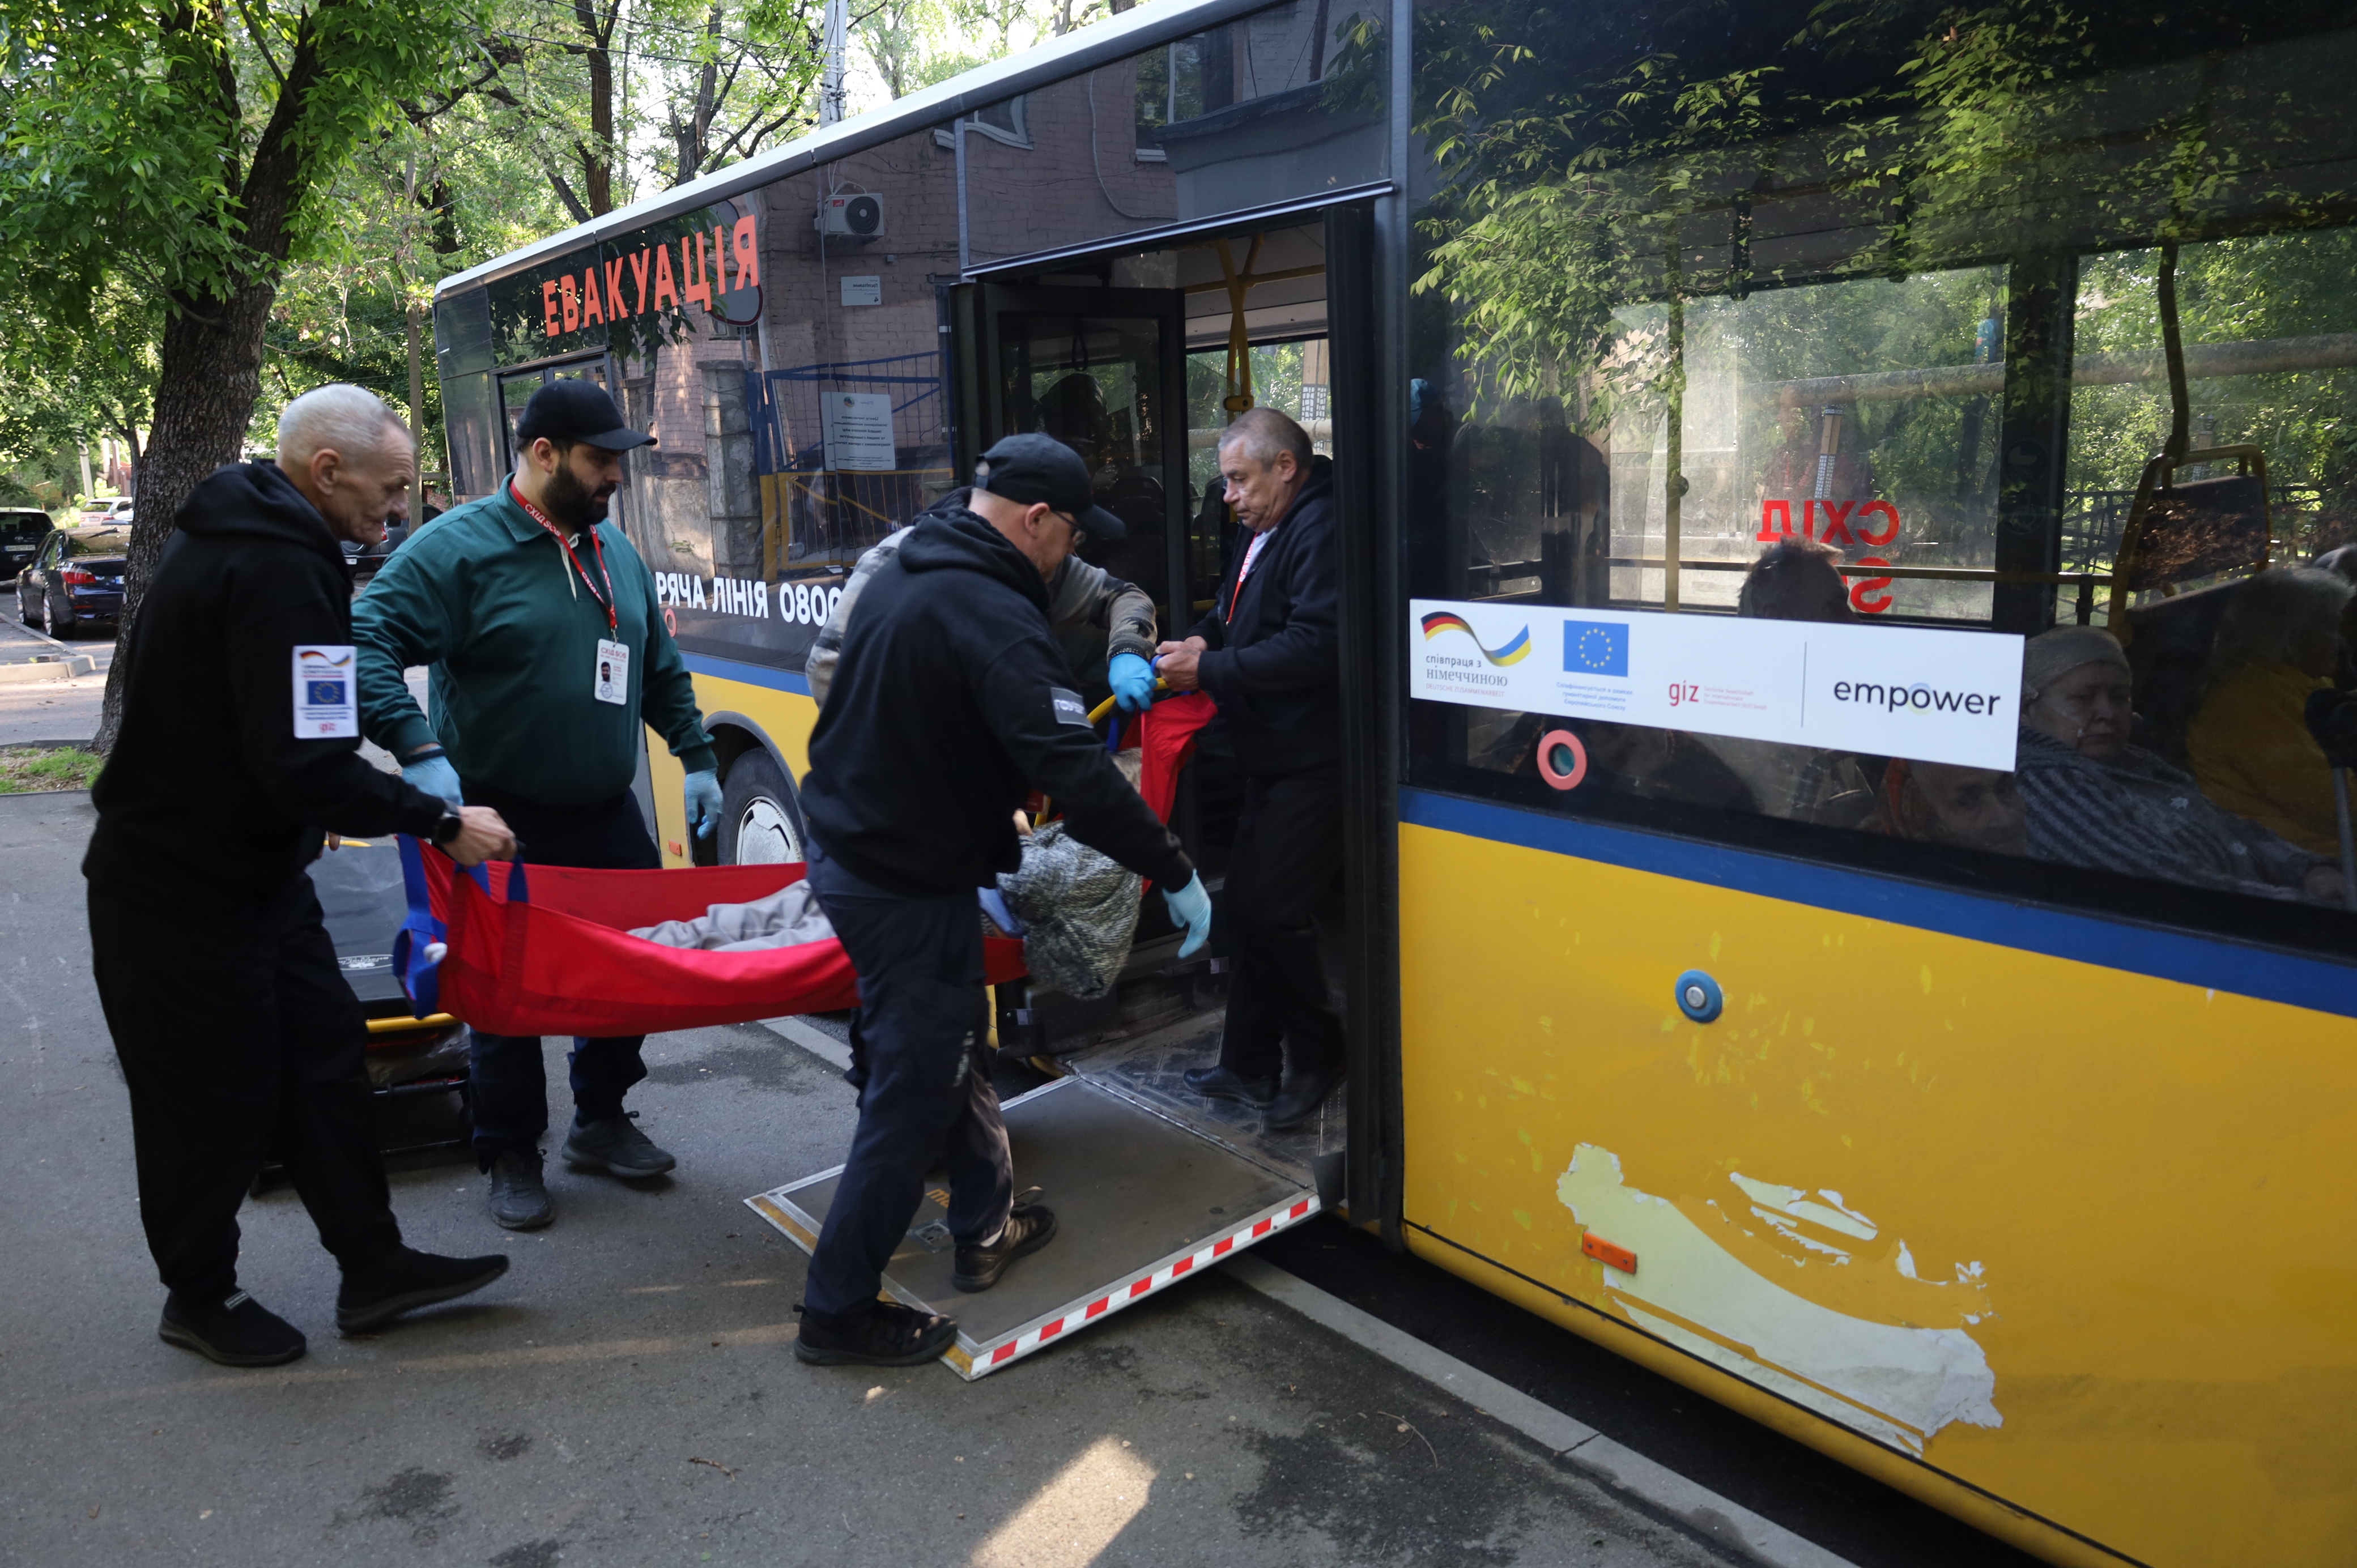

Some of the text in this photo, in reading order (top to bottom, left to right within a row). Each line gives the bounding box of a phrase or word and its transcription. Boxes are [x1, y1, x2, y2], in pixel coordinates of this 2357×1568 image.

[542, 214, 759, 337] ЕВАКУАЦІЯ
[525, 503, 546, 524] СХІД
[712, 577, 769, 619] ЛІНІЯ
[1426, 654, 1473, 667] співпраця
[1426, 665, 1508, 687] німеччиною
[1426, 683, 1505, 697] DEUTSCHE ZUSAMMENARBEIT
[1669, 679, 1699, 707] giz
[1833, 680, 2001, 716] empower
